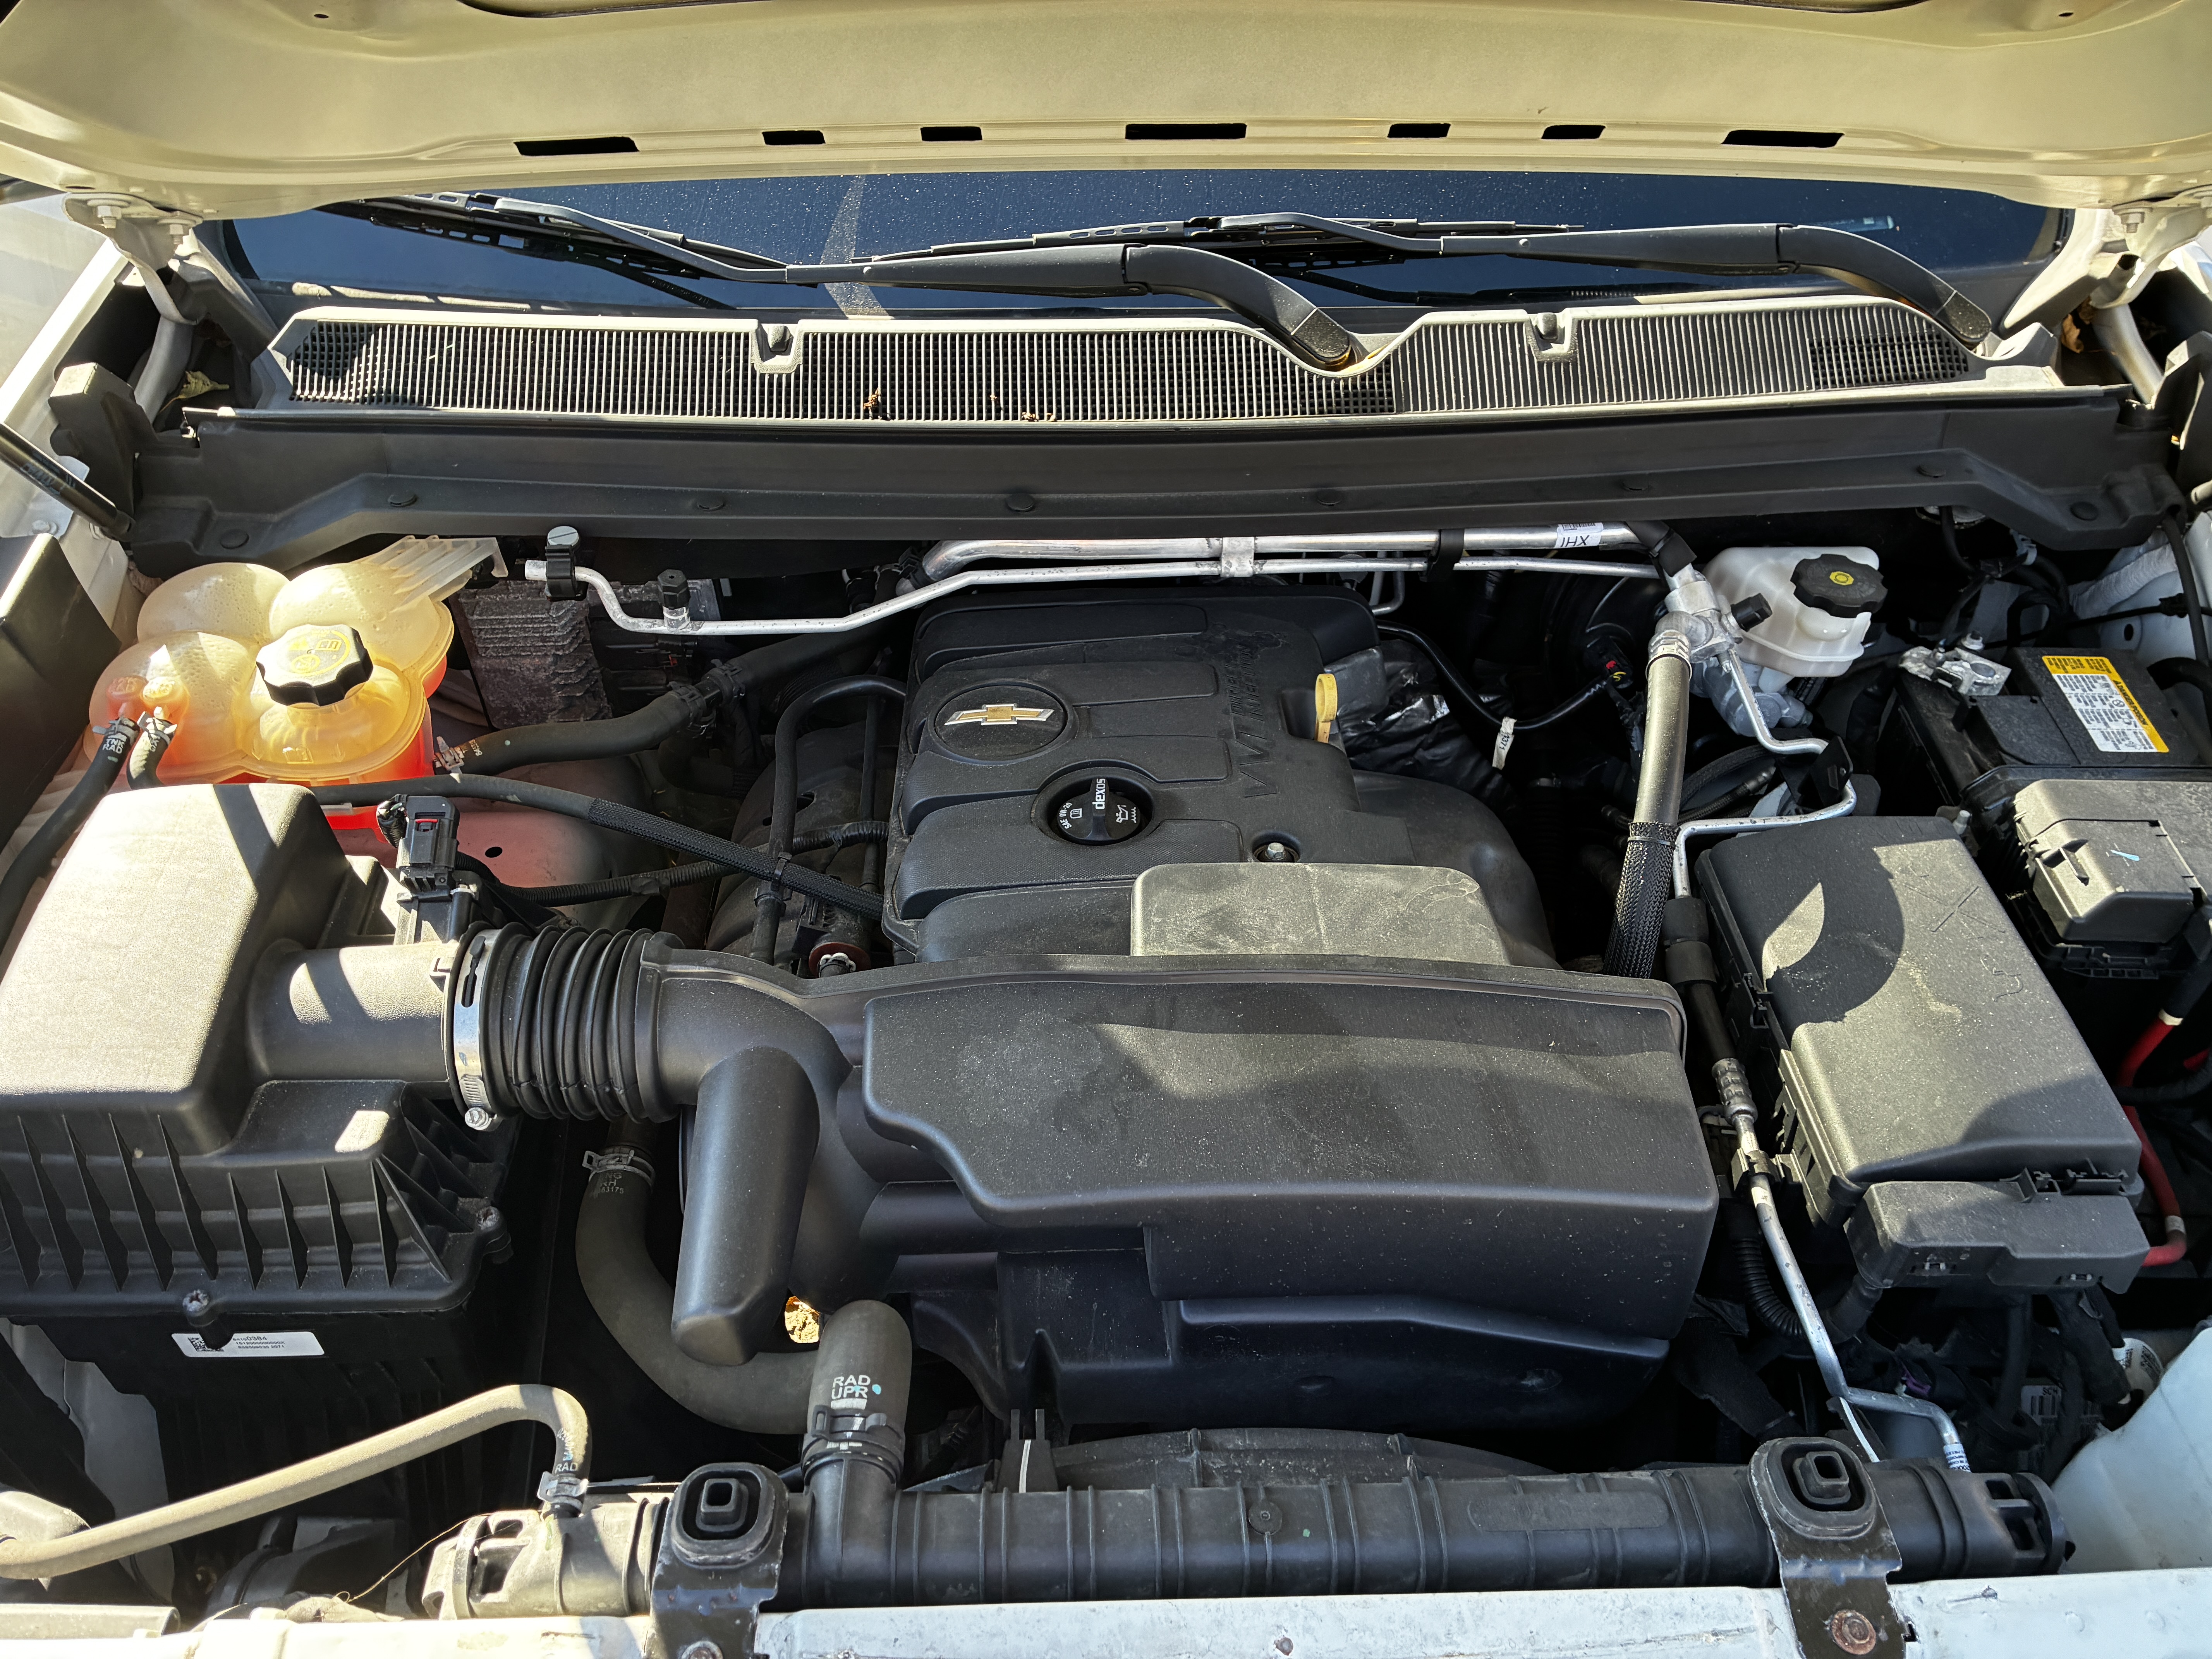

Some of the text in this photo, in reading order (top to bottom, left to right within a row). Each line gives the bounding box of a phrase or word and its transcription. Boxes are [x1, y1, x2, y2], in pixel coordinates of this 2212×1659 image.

[102, 744, 122, 754] RAD
[106, 738, 125, 749] TNK
[1092, 778, 1106, 810] dexos
[1059, 802, 1072, 829] SAE 0W-20
[832, 1375, 871, 1388] RAD
[831, 1386, 868, 1400] UPR
[555, 1462, 579, 1474] RAD
